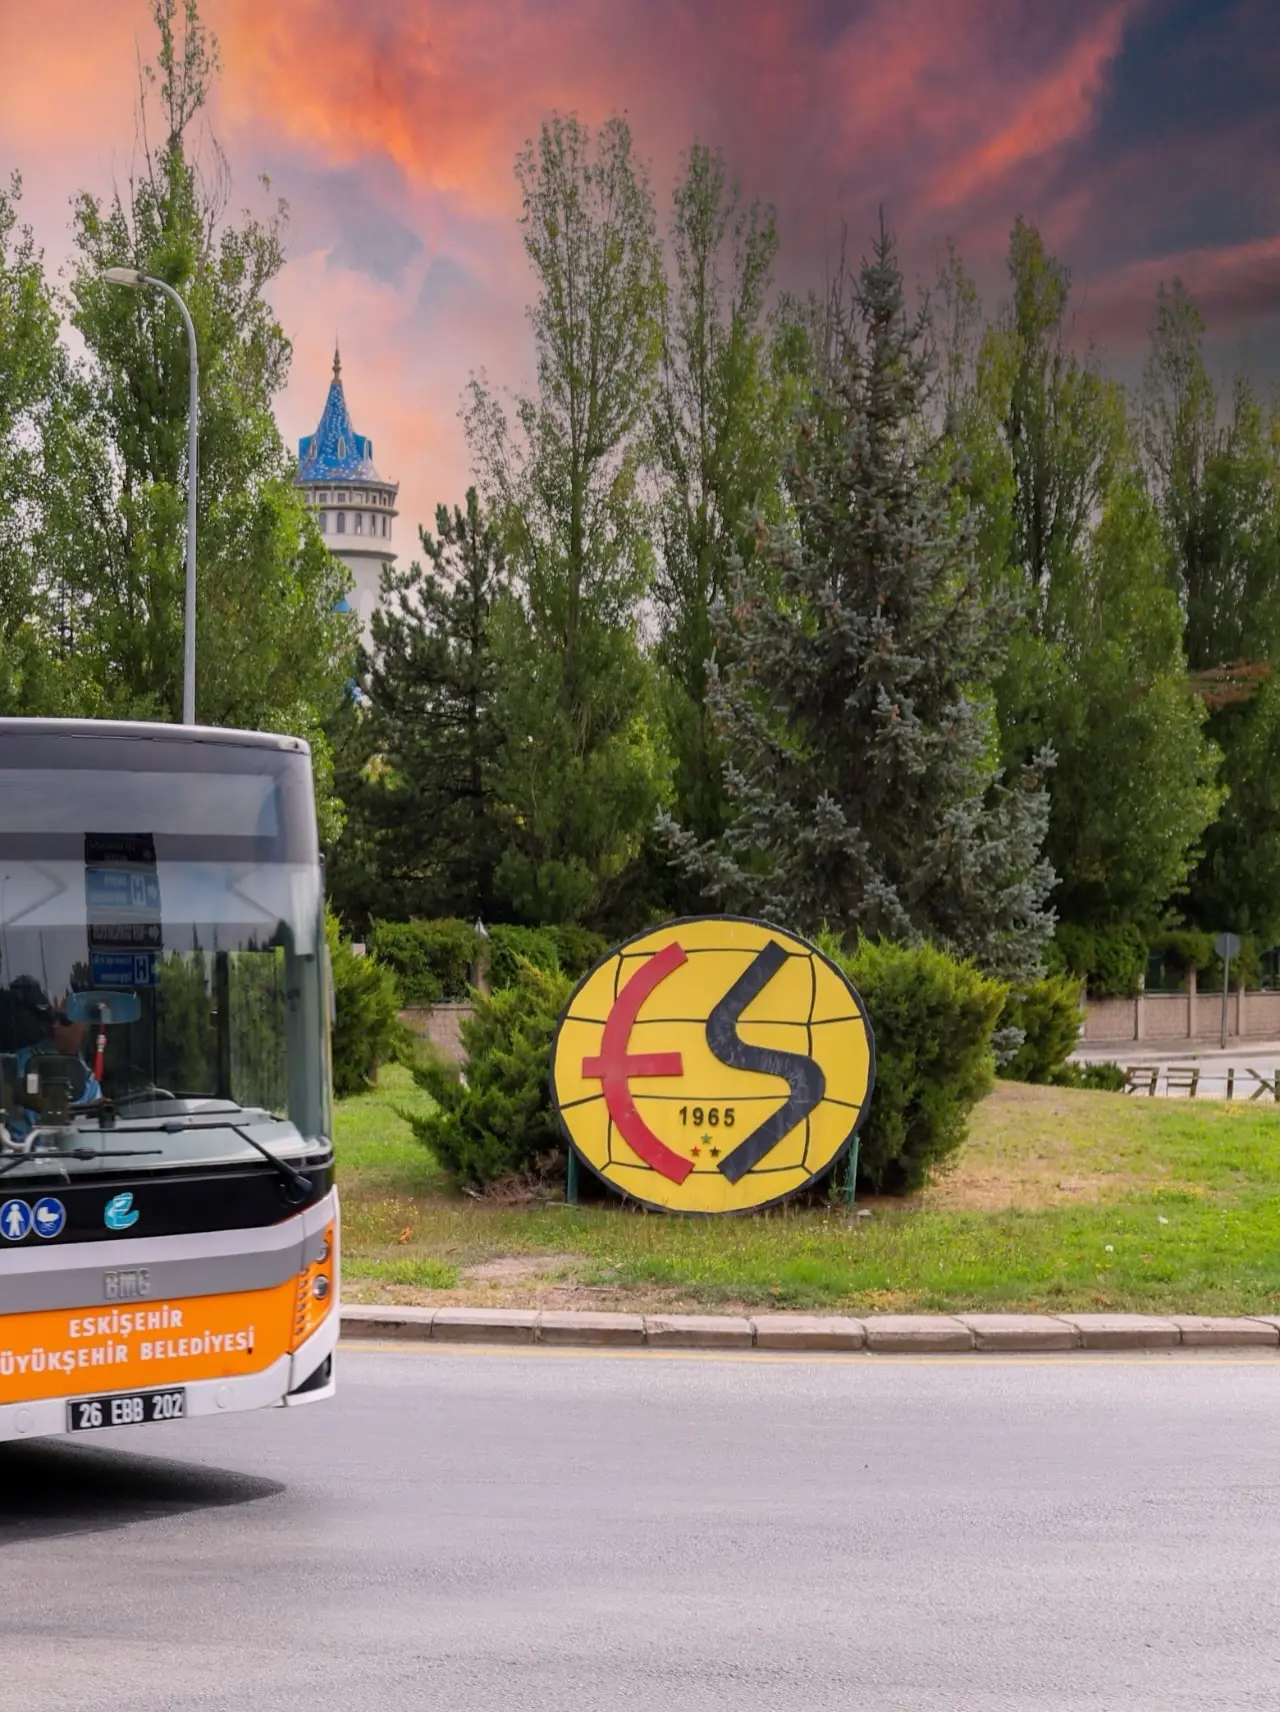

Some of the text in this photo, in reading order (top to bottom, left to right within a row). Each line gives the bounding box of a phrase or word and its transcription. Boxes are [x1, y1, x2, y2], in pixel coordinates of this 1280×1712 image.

[679, 1106, 736, 1127] 1965
[70, 1305, 183, 1338] ESKİŞEHİR
[140, 1326, 255, 1361] BELEDİYESİ
[79, 1393, 183, 1428] 26 EBB 202
